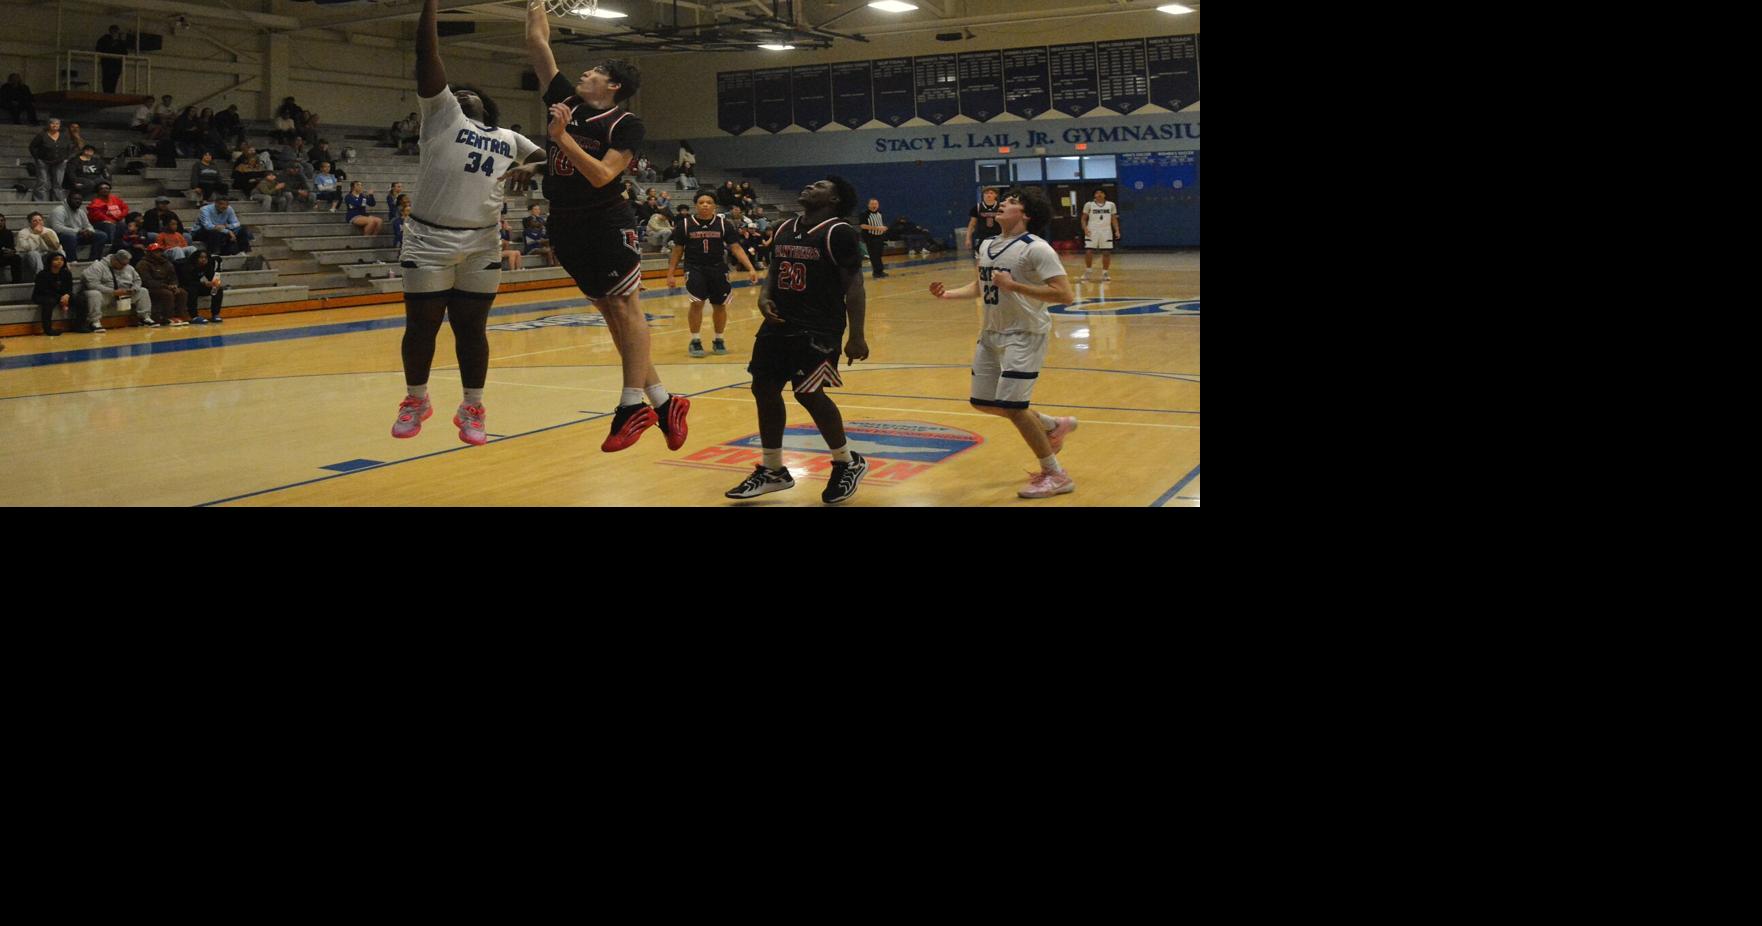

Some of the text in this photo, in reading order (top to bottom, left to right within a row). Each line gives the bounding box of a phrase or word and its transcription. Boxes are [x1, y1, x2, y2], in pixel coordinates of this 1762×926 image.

[455, 128, 514, 159] CENTRAL
[875, 122, 1200, 153] STACY L. LAIL, JR. GYMNASIU
[464, 151, 495, 177] 34
[702, 239, 709, 254] 1
[778, 260, 807, 292] 20
[983, 284, 999, 305] 23
